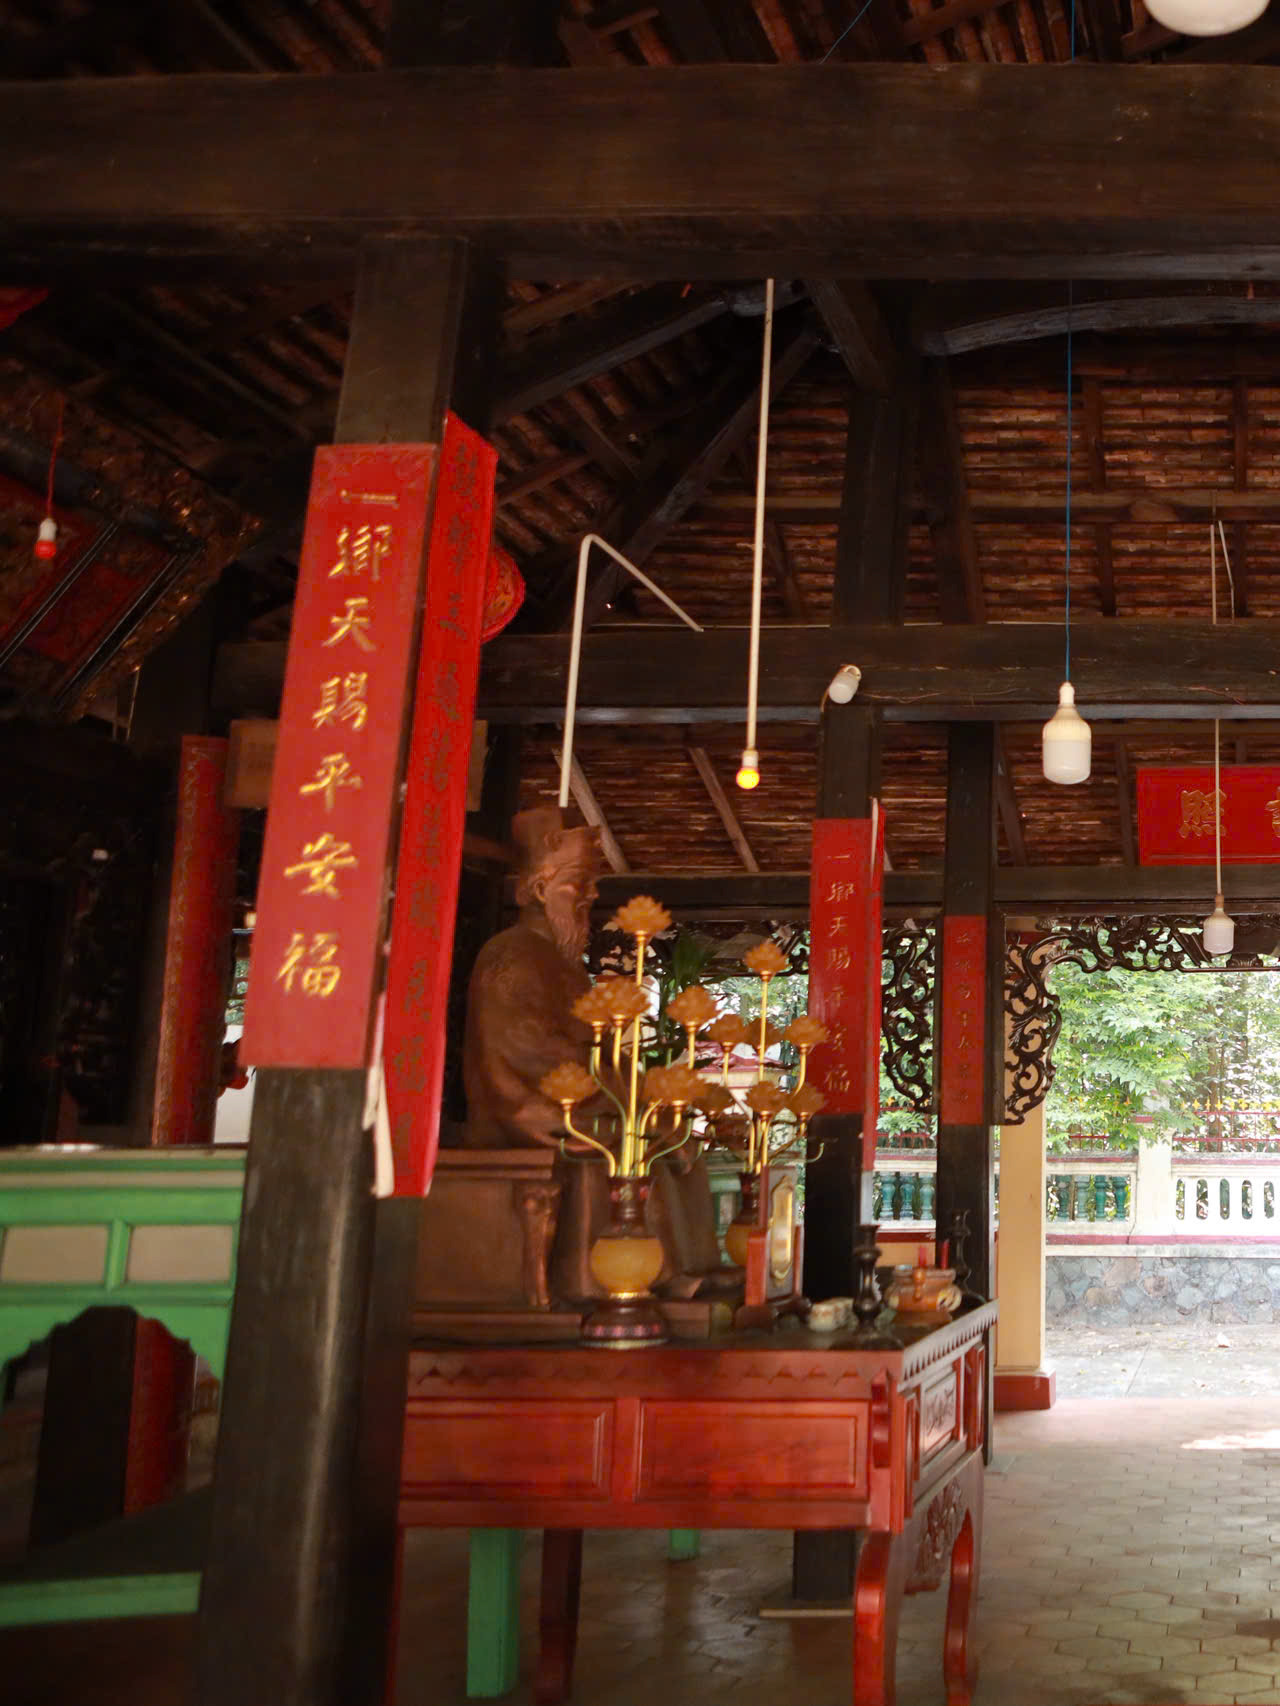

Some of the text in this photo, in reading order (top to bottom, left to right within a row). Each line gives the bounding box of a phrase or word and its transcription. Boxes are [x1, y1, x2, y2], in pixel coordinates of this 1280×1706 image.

[273, 488, 401, 1000] 一鄉天賜平安福
